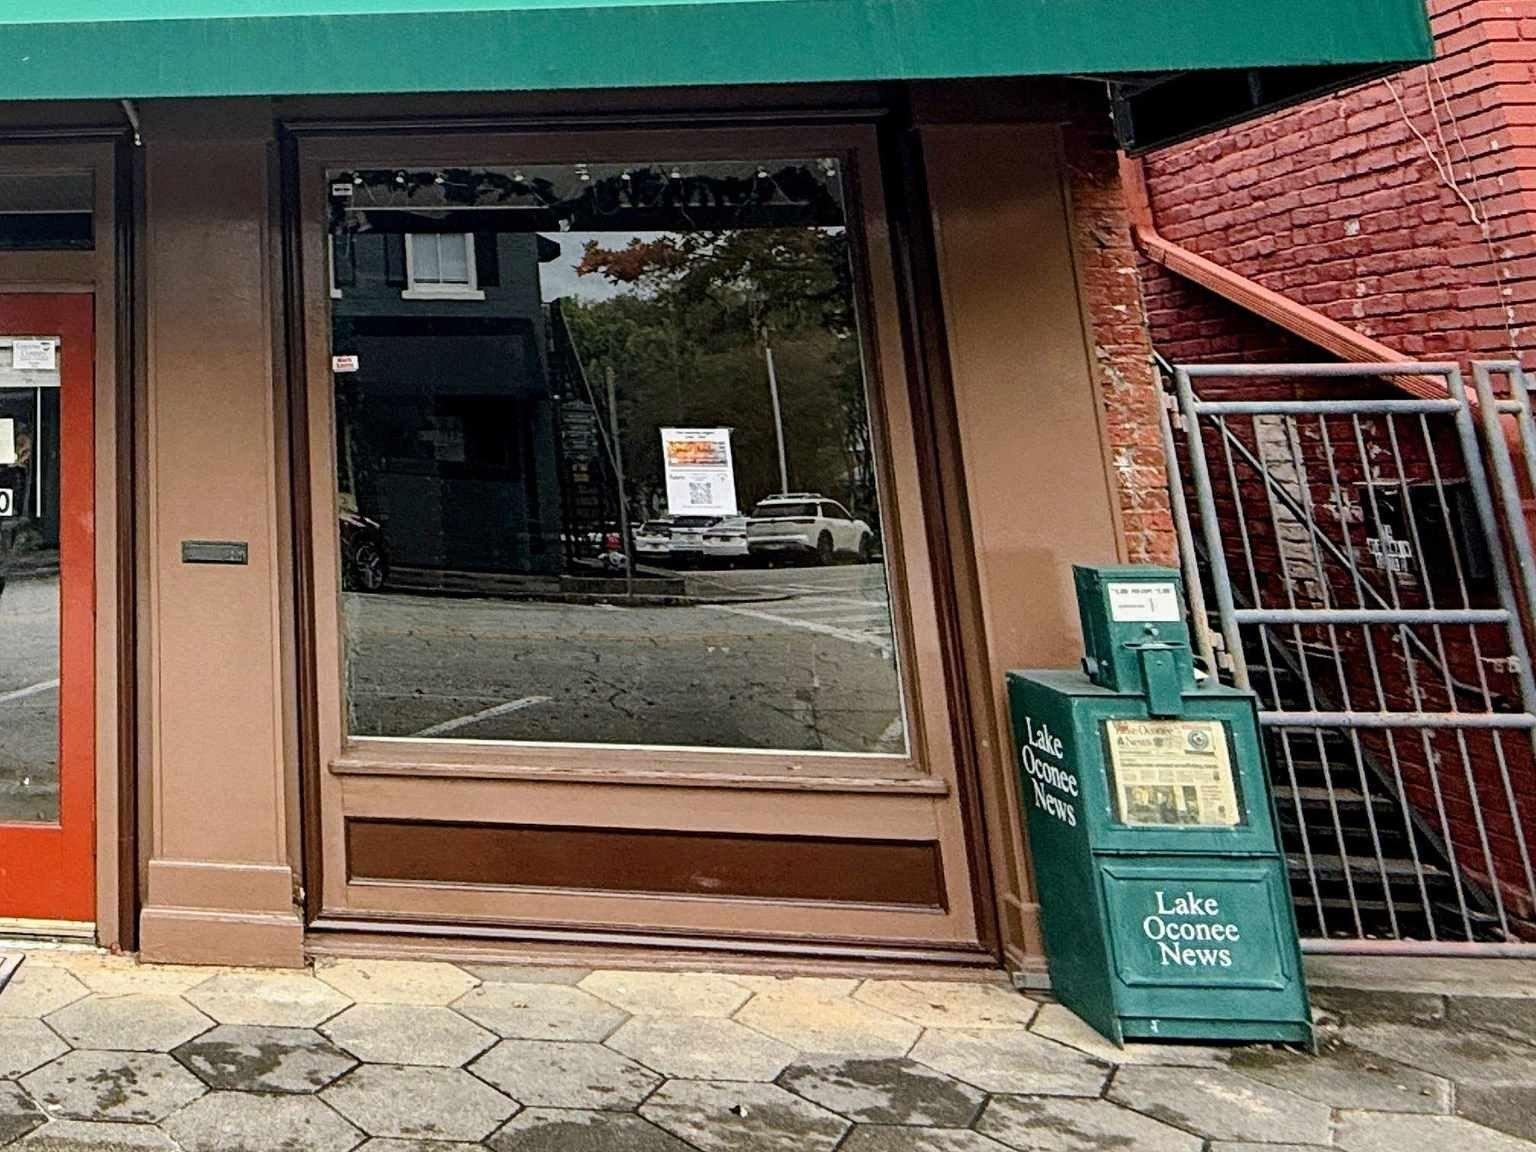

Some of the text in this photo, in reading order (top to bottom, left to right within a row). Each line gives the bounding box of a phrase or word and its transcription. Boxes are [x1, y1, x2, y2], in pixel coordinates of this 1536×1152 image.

[1025, 716, 1064, 760] Lake
[1022, 745, 1079, 797] Oconee
[1031, 777, 1077, 827] News
[1154, 891, 1220, 916] Lake
[1143, 915, 1241, 942] Oconee
[1156, 941, 1233, 967] News
